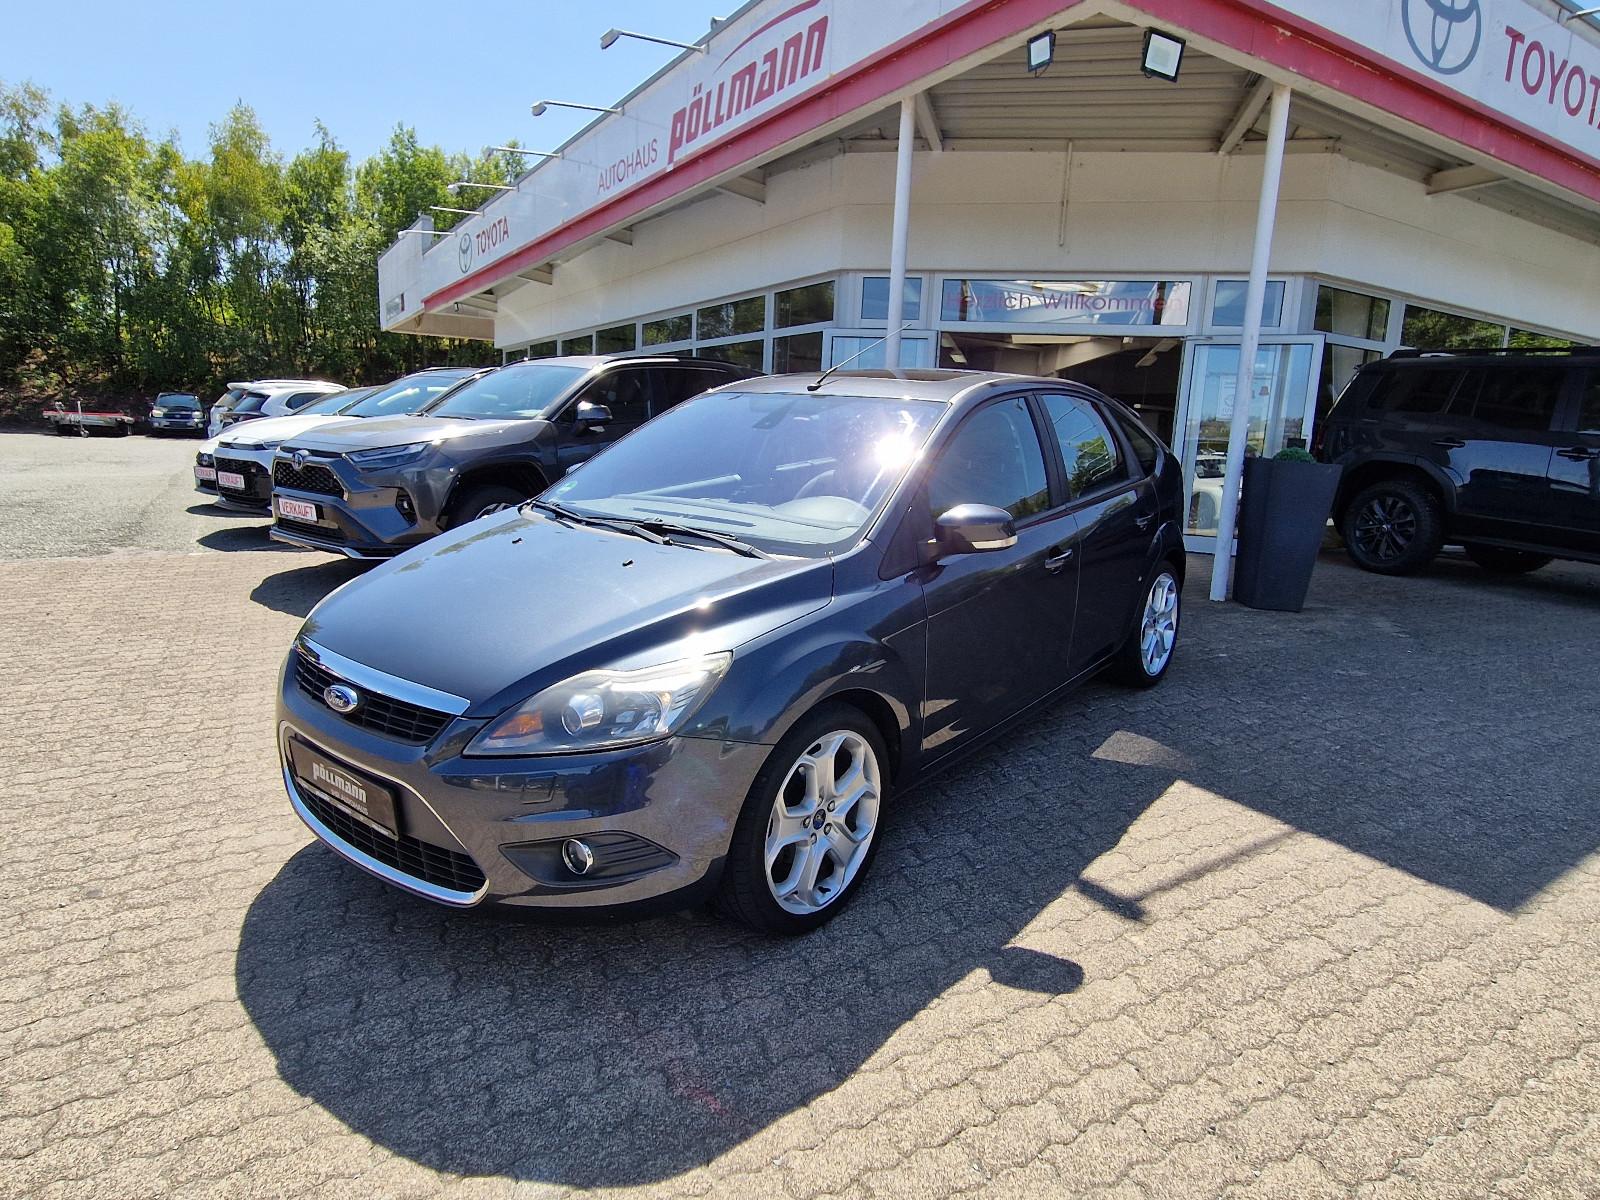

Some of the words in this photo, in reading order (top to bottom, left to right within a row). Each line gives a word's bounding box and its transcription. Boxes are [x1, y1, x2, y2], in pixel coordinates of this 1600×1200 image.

[1505, 25, 1600, 129] TOYOT
[597, 138, 658, 193] AUTOHAUS
[475, 215, 510, 257] TOYOTA
[1042, 293, 1185, 311] Willkommen
[281, 500, 315, 518] VERKAUFT
